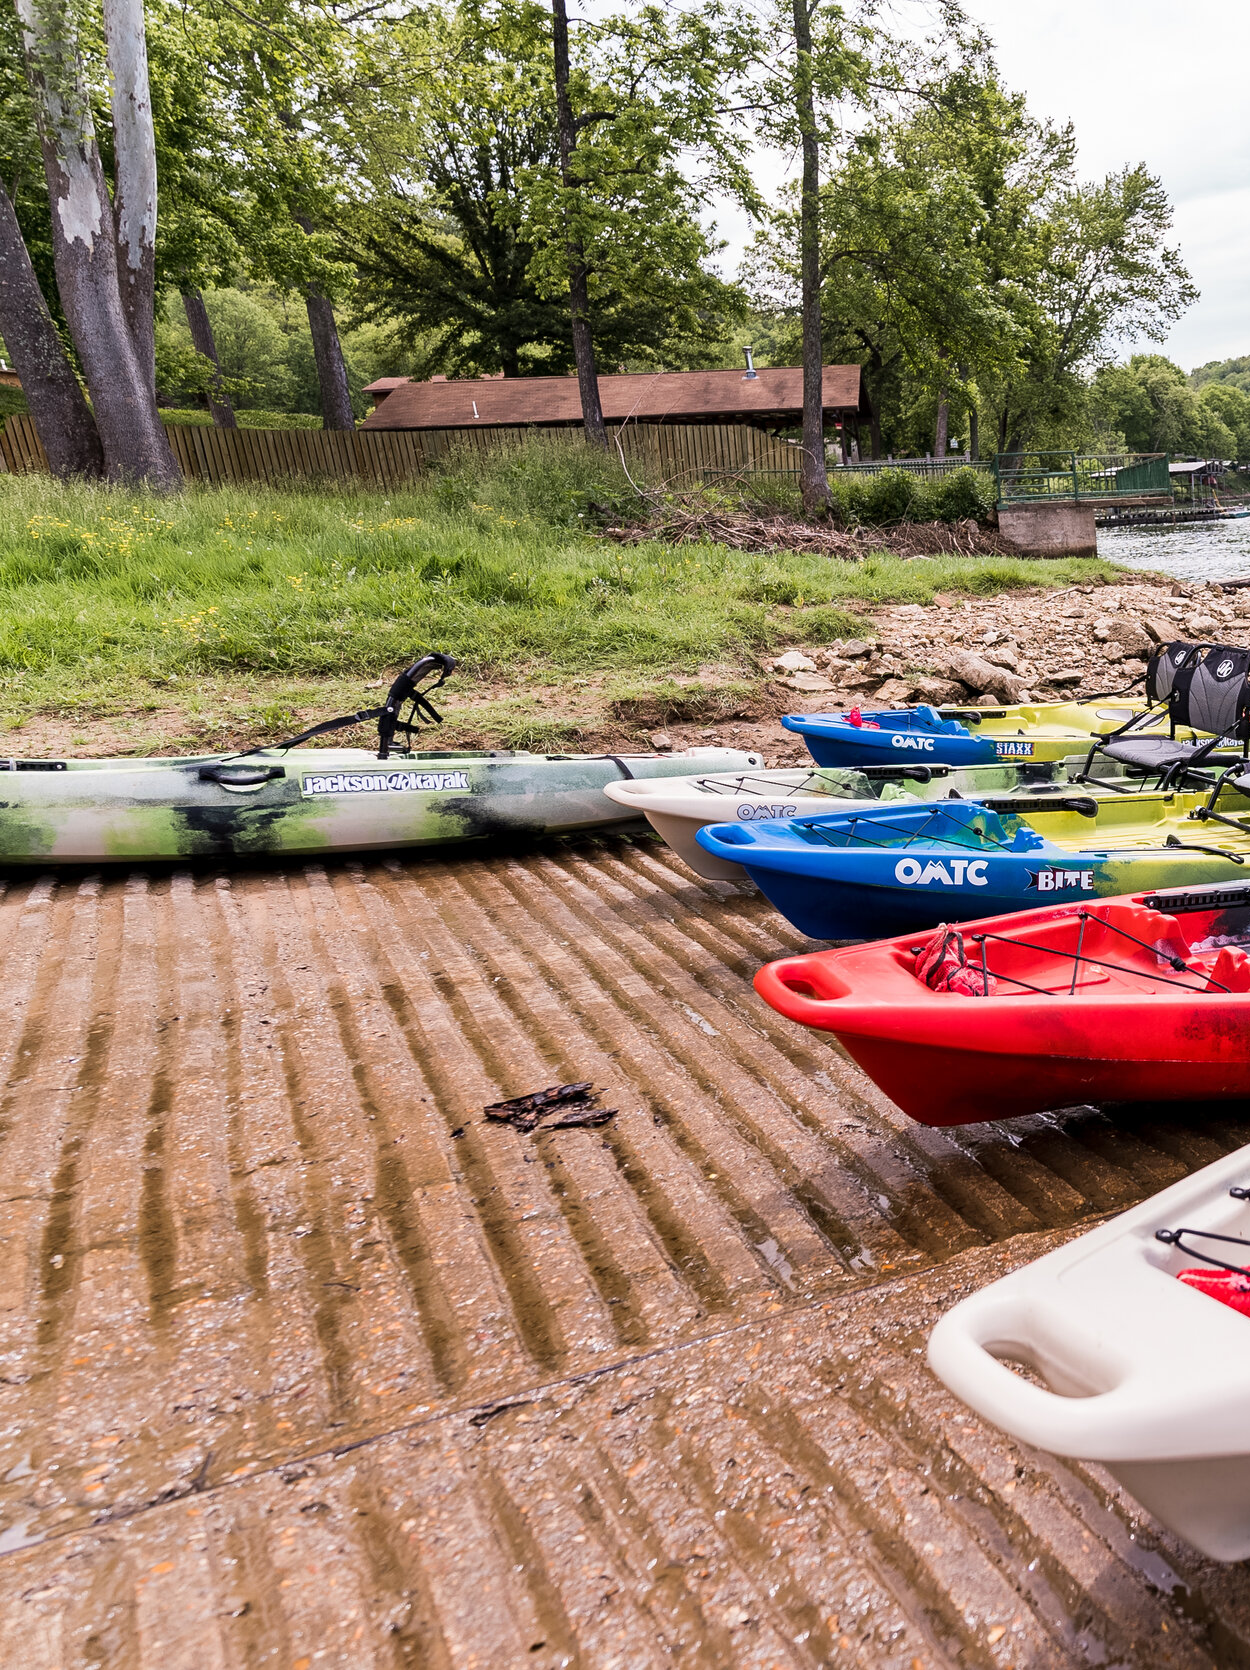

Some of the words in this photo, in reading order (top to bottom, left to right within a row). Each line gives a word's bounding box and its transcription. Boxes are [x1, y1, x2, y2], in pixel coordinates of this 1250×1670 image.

[891, 734, 935, 751] OMTC
[995, 742, 1033, 755] STAXX
[409, 771, 469, 791] kayak
[737, 804, 797, 820] OMTC
[894, 857, 989, 886] OMTC
[1037, 870, 1095, 892] BITE
